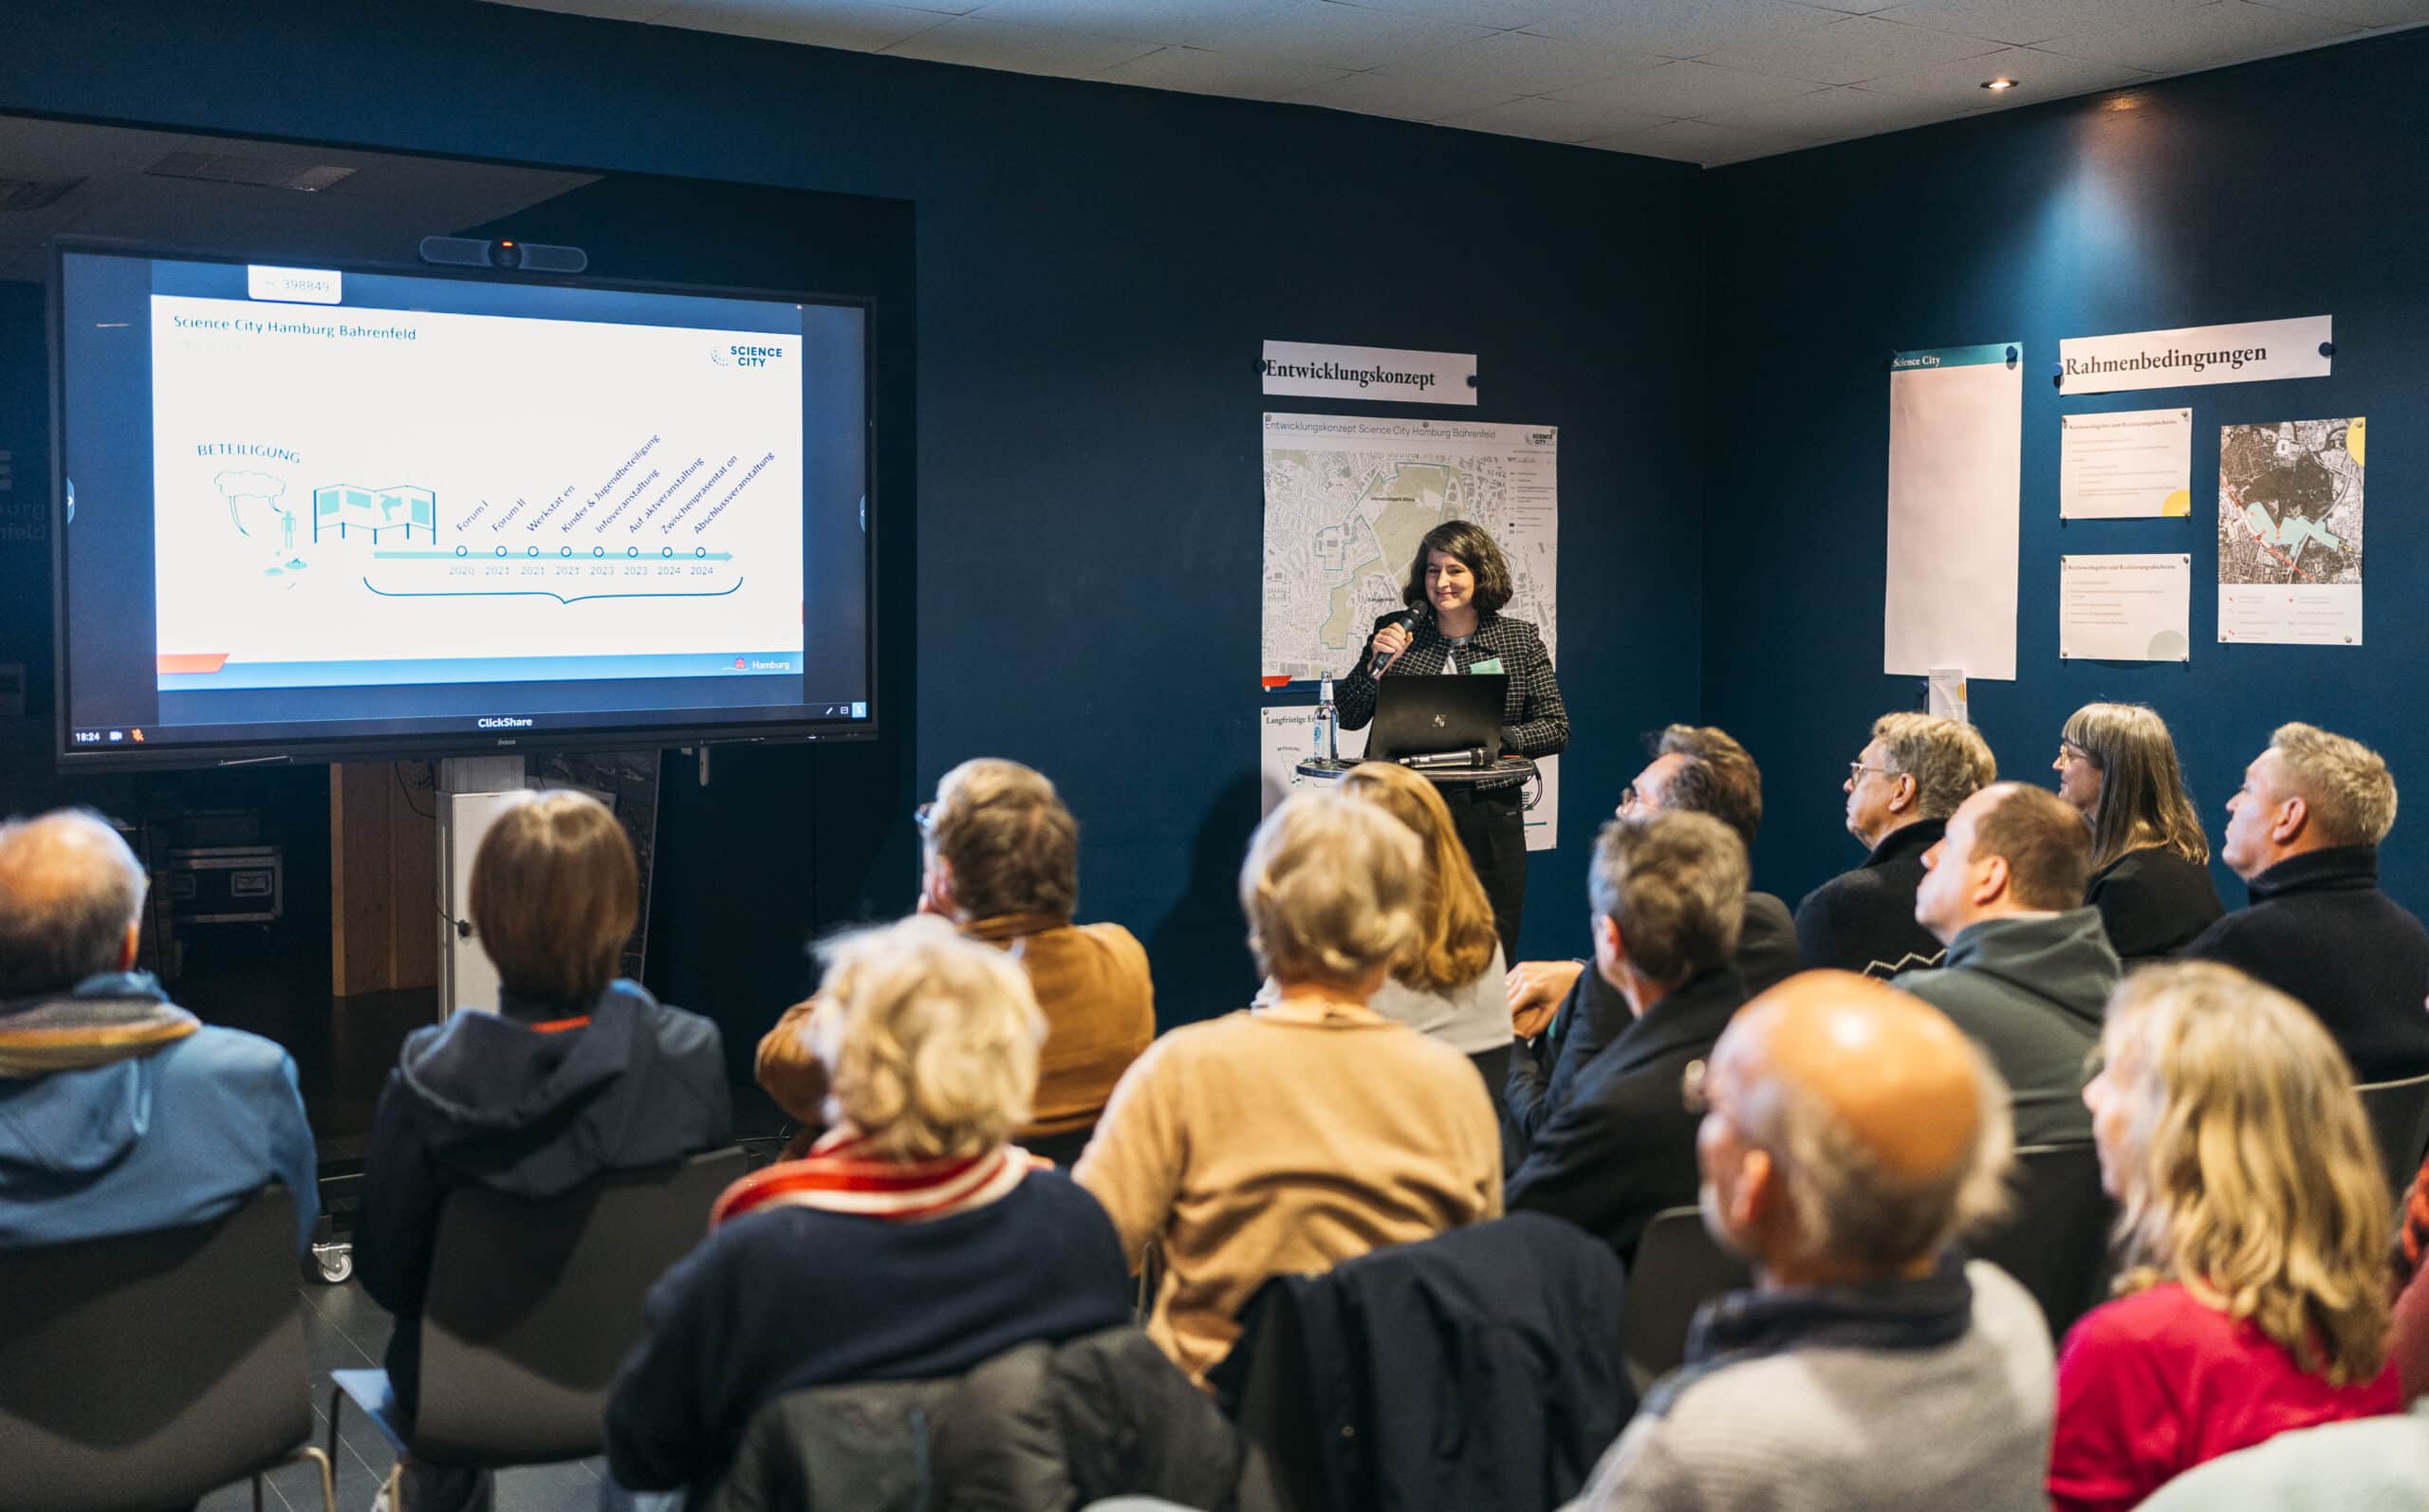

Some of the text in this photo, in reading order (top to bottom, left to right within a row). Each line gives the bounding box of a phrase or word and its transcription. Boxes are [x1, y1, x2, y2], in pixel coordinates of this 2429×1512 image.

[174, 315, 417, 340] Science City Hamburg Bahrenfeld
[731, 345, 783, 357] SCIENCE
[737, 357, 766, 367] CITY
[1893, 355, 1941, 367] Science City
[2066, 347, 2267, 376] Rahmenbedingungen
[1266, 359, 1436, 391] Entwicklungskonzept
[1265, 421, 1495, 439] Entwicklungskonzept Science City Hamburg Bahrenfeld
[197, 443, 301, 464] BETEILIGUNG
[594, 468, 660, 533] Infoveranstaltung
[694, 451, 774, 534] Abschlussveranstaltung
[455, 507, 485, 532] Forum
[491, 507, 521, 532] Forum
[658, 566, 681, 575] 2024
[691, 566, 714, 575] 2024
[752, 660, 790, 671] Hamburg
[478, 718, 532, 728] ClickShare
[1266, 715, 1307, 727] Langfristige
[76, 732, 100, 742] 18:24
